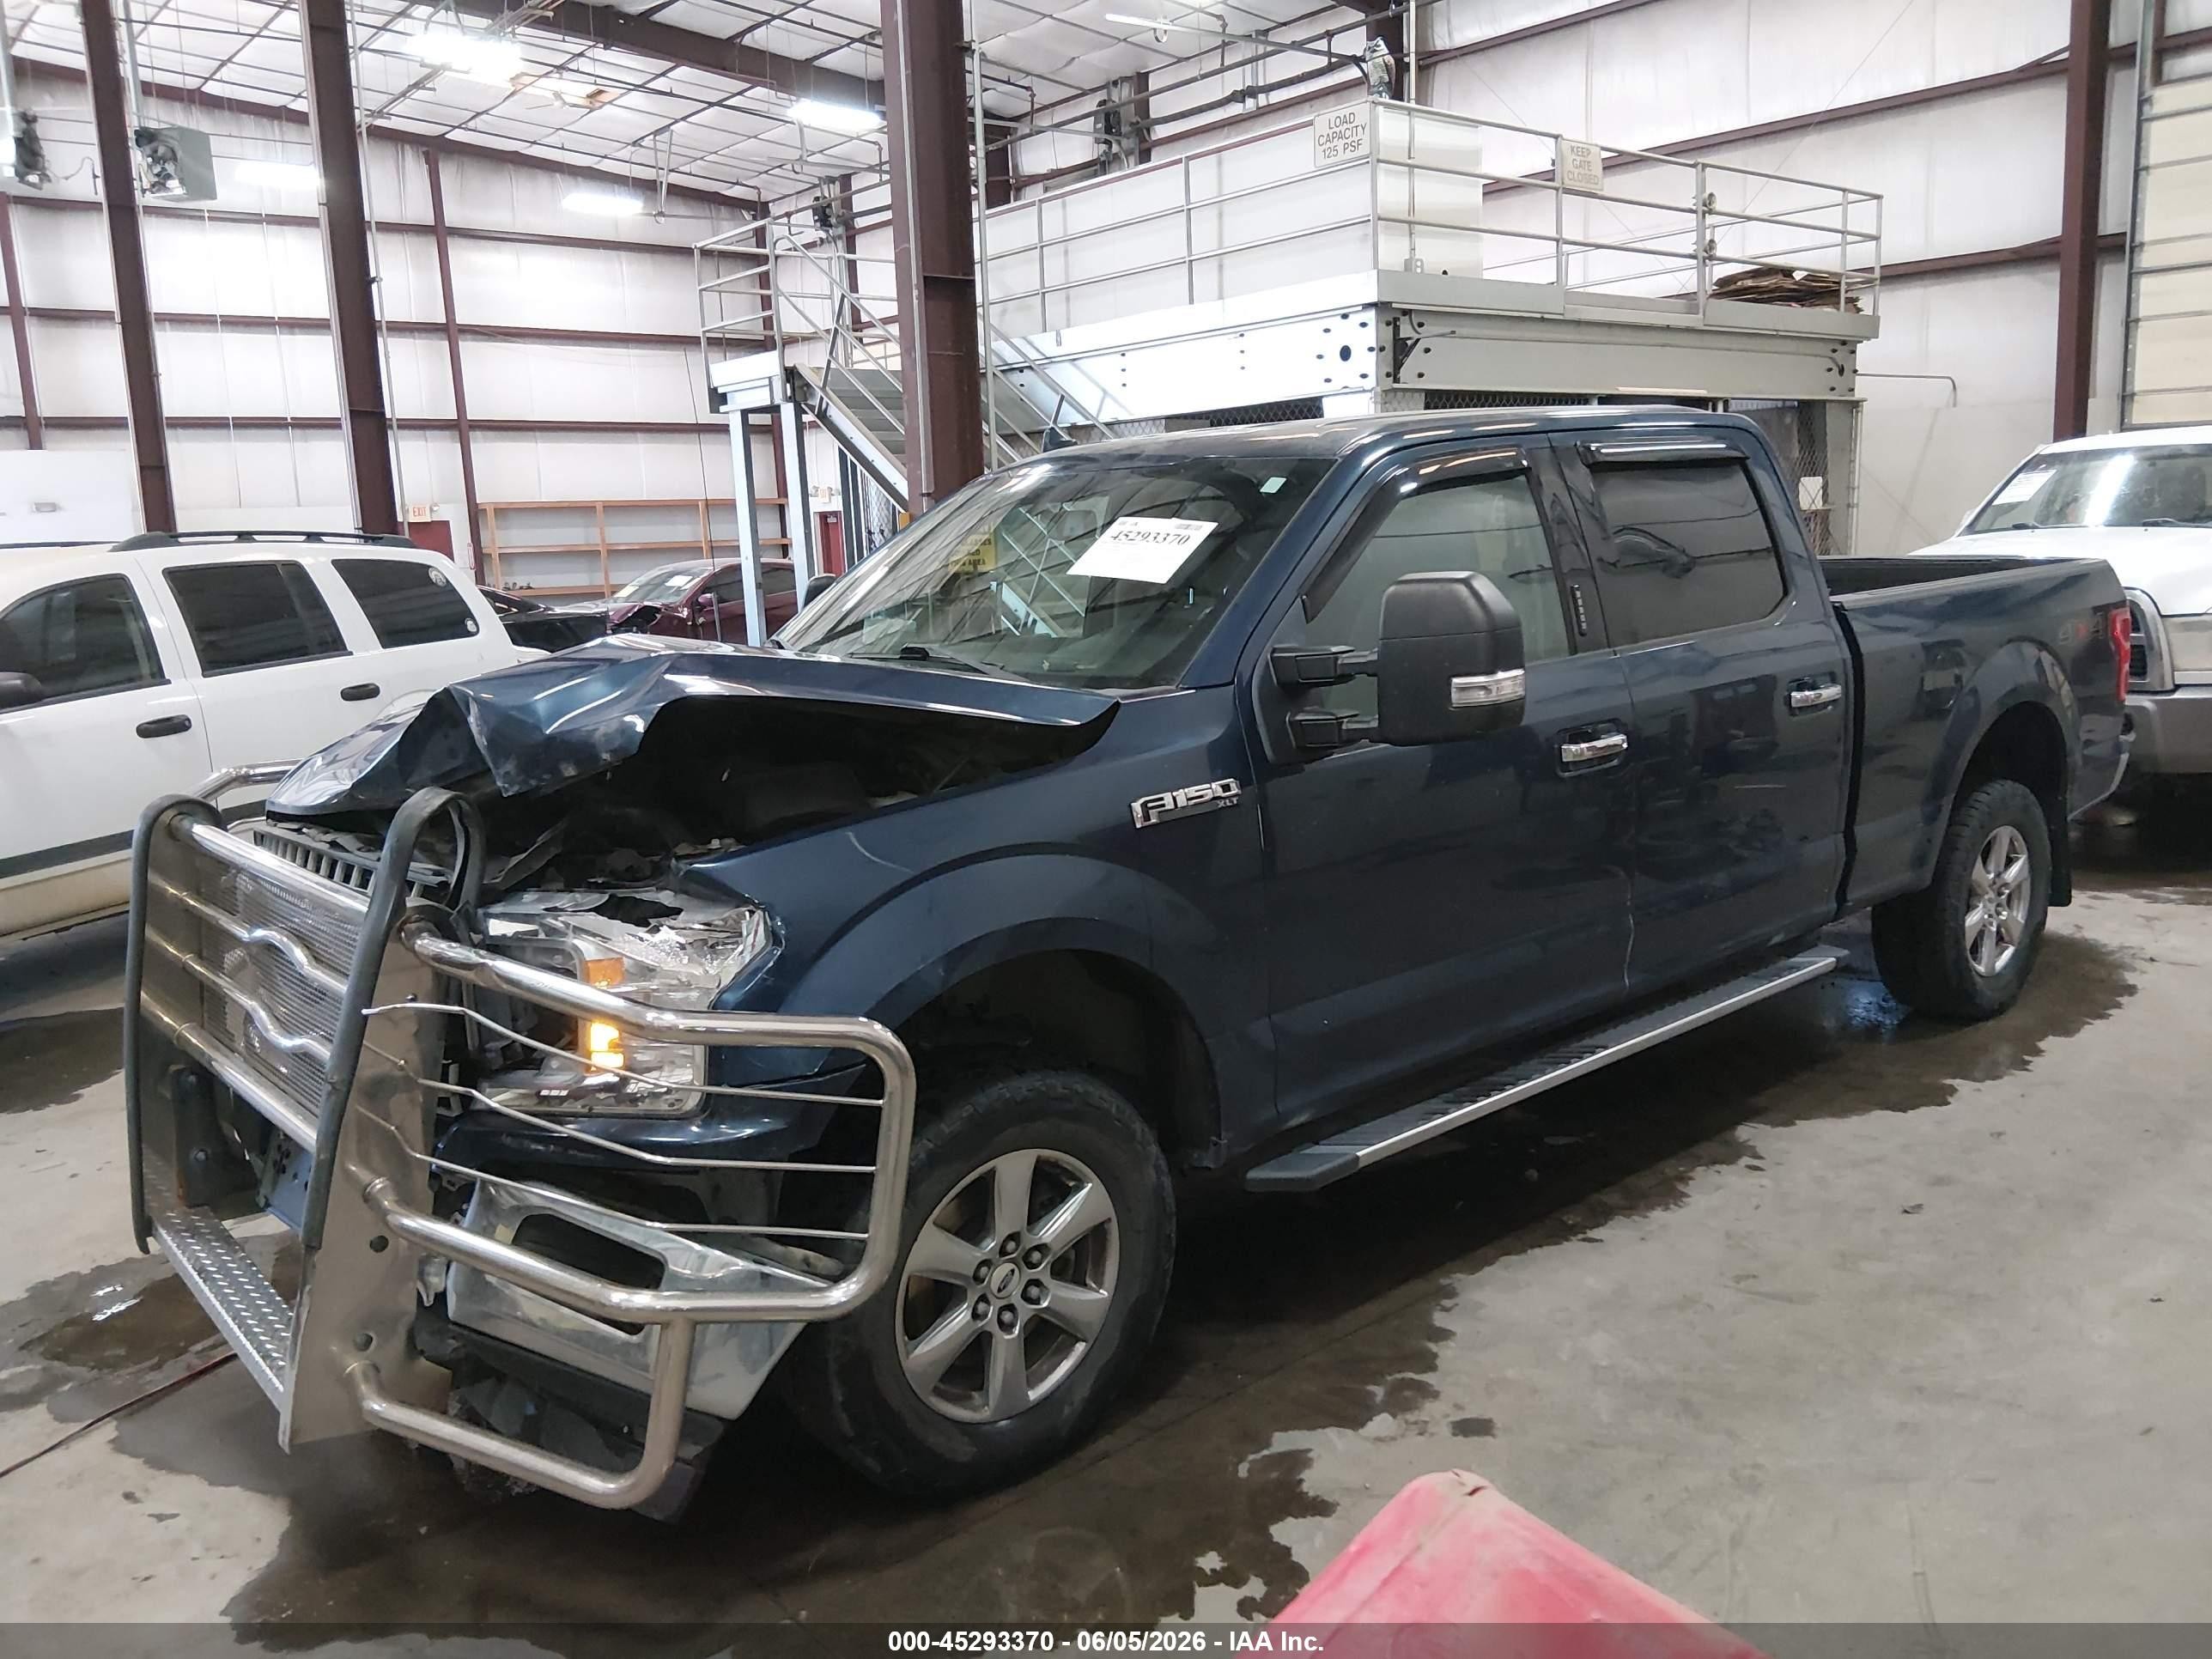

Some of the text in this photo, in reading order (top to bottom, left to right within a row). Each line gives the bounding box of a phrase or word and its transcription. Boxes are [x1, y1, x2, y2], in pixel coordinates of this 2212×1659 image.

[1328, 112, 1356, 130] LOAD
[1317, 122, 1367, 147] CAPACITY
[1322, 138, 1363, 160] 125 PSF
[1571, 144, 1592, 157] KEEP
[1571, 158, 1593, 172] GATE
[1566, 170, 1600, 185] CLOSED
[1110, 530, 1191, 546] 45293370
[1217, 797, 1239, 808] XLT
